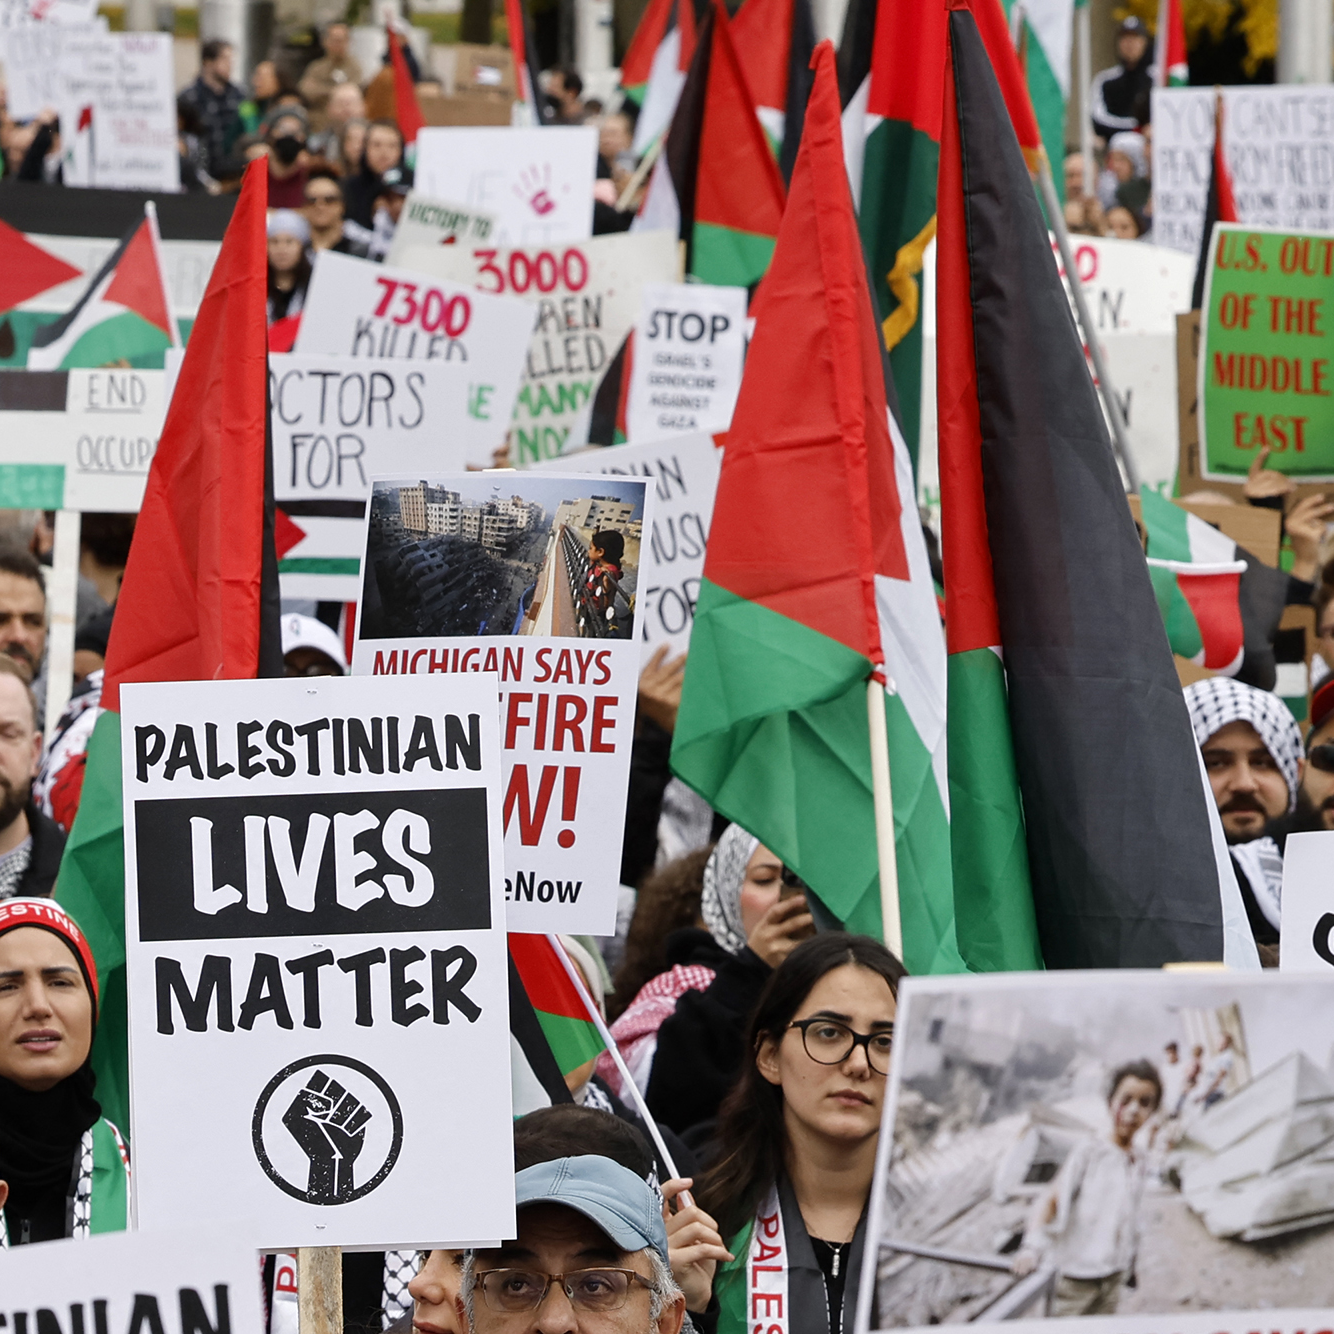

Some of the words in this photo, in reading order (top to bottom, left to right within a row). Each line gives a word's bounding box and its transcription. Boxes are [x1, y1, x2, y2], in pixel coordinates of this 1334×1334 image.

[473, 247, 589, 295] 3000
[1217, 231, 1269, 273] U.S.
[373, 276, 473, 338] 7300
[647, 309, 731, 343] STOP
[1219, 291, 1258, 332] OF
[1266, 294, 1326, 338] THE
[87, 372, 146, 408] END
[1211, 350, 1332, 397] MIDDLE
[76, 433, 160, 470] OCCUP
[1233, 411, 1310, 454] EAST
[290, 433, 367, 490] FOR
[372, 646, 525, 683] MICHIGAN
[533, 647, 612, 686] SAYS
[134, 713, 482, 783] PALESTINIAN
[189, 808, 435, 916] LIVES
[155, 944, 483, 1036] MATTER
